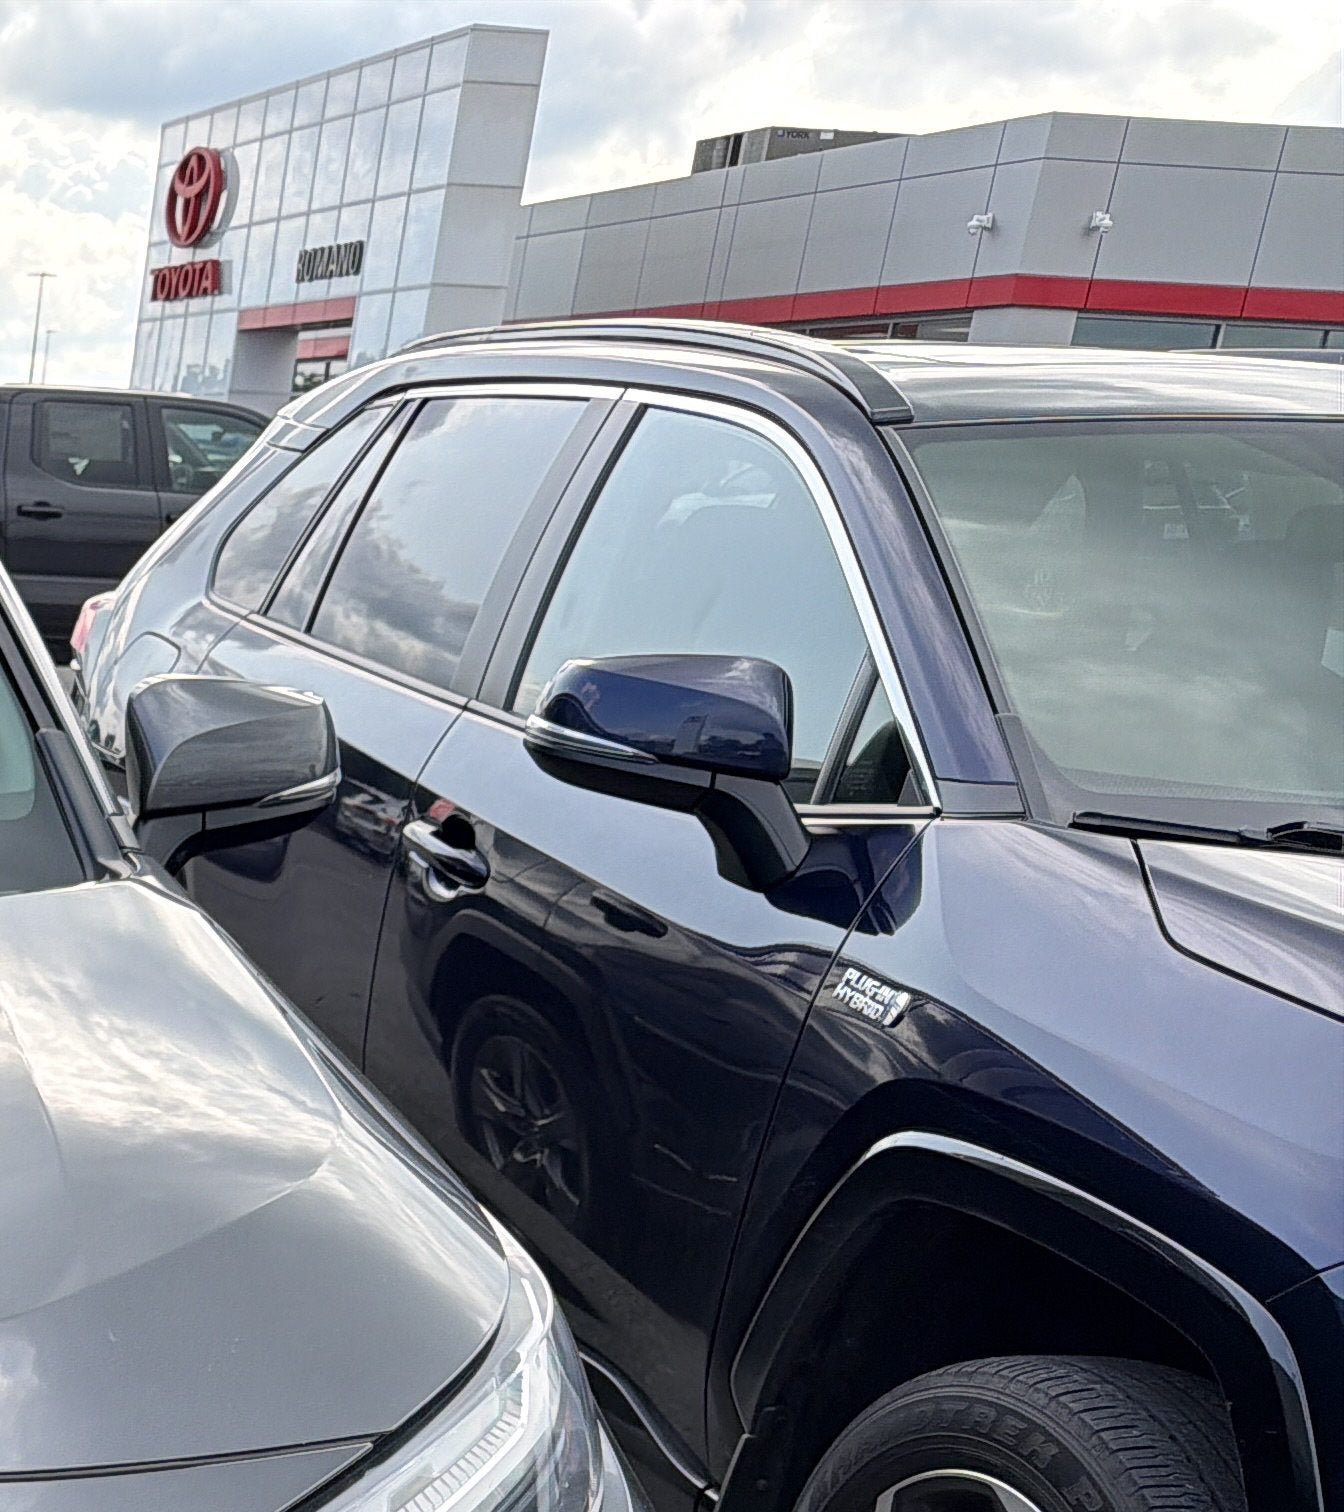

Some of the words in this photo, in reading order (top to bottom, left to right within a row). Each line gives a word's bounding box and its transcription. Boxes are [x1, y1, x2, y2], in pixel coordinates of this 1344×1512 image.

[151, 259, 219, 302] TOYOTA
[296, 241, 362, 284] ROMANO
[831, 982, 885, 1020] HYBRID
[842, 967, 898, 1004] PLUG-IN
